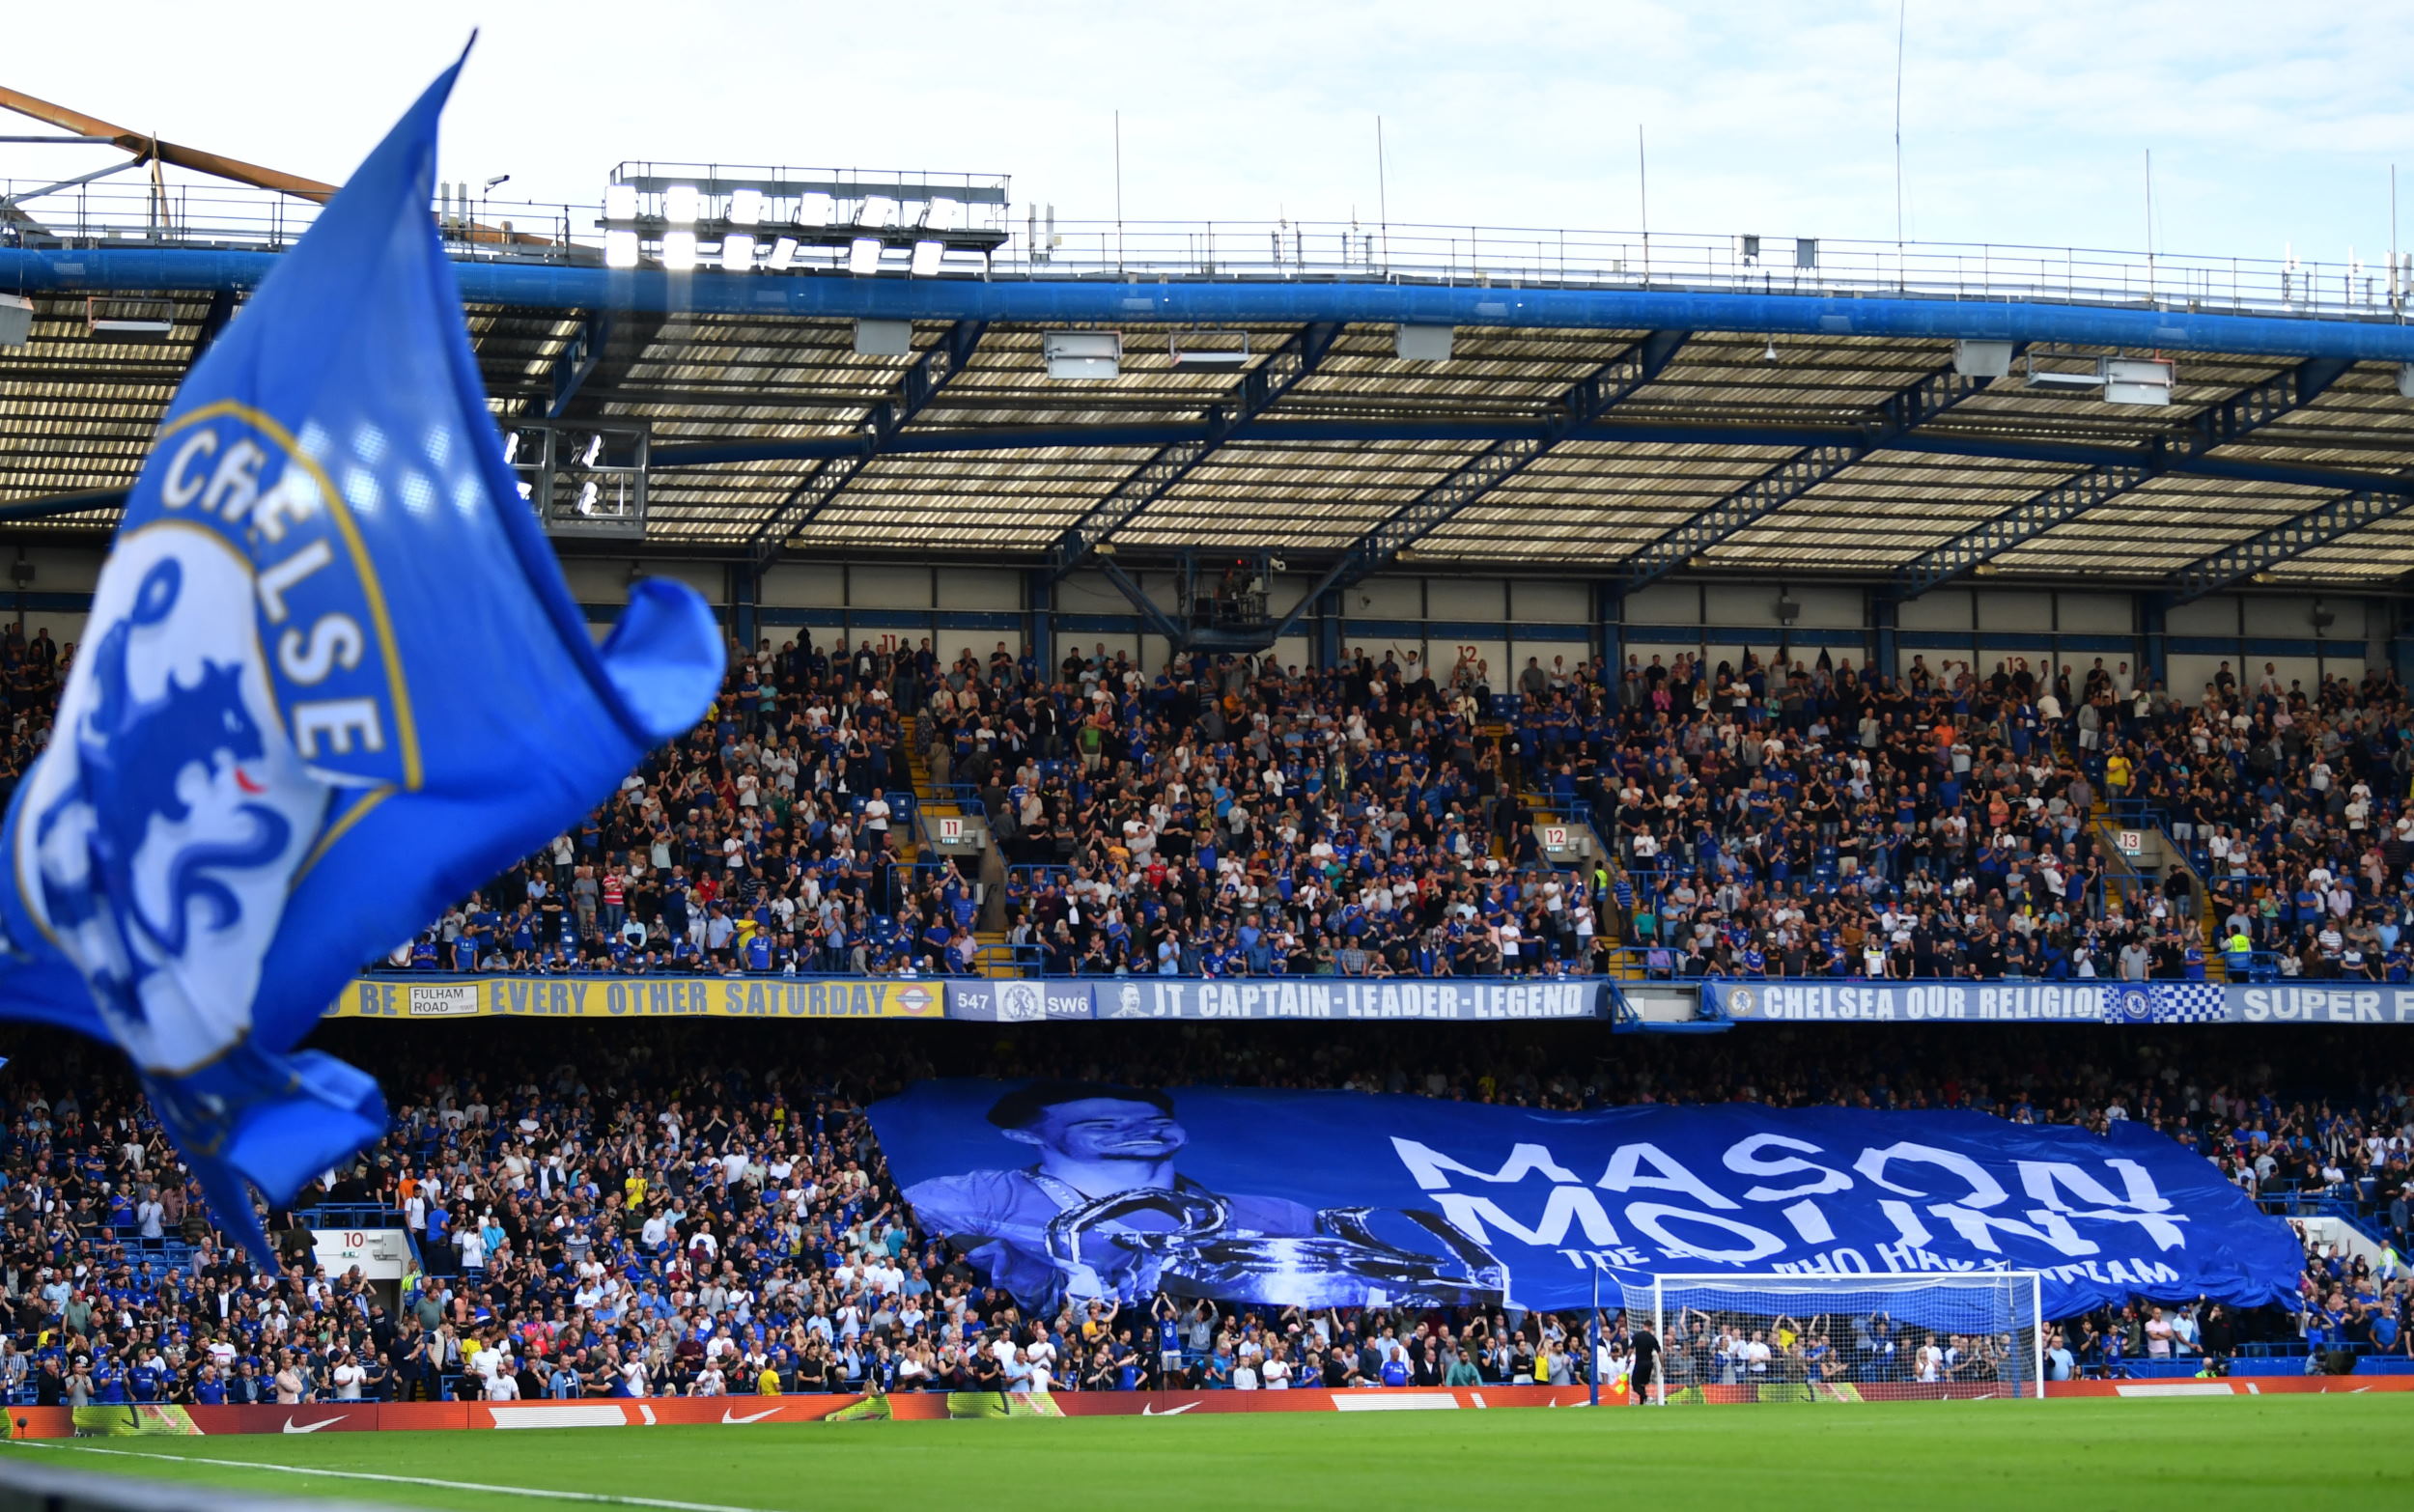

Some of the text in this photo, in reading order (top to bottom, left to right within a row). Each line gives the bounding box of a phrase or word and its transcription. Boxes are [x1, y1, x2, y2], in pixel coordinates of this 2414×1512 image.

[160, 430, 385, 763] CHELSE
[881, 633, 896, 652] 11
[945, 822, 958, 835] 11
[1547, 829, 1564, 843] 12
[2122, 833, 2138, 848] 13
[360, 980, 887, 1016] BE EVERY OTHER SATURDAY
[413, 988, 463, 999] FULHAM
[957, 993, 990, 1010] 547
[1048, 996, 1089, 1013] SW6
[1154, 983, 1184, 1018] JT
[1763, 986, 1895, 1021] CHELSEA
[1906, 985, 1966, 1020] OUR
[414, 1001, 449, 1013] ROAD
[2243, 988, 2383, 1022] SUPER
[1389, 1133, 2174, 1213] MASON
[344, 1232, 364, 1247] 10
[1557, 1246, 1650, 1269] THE
